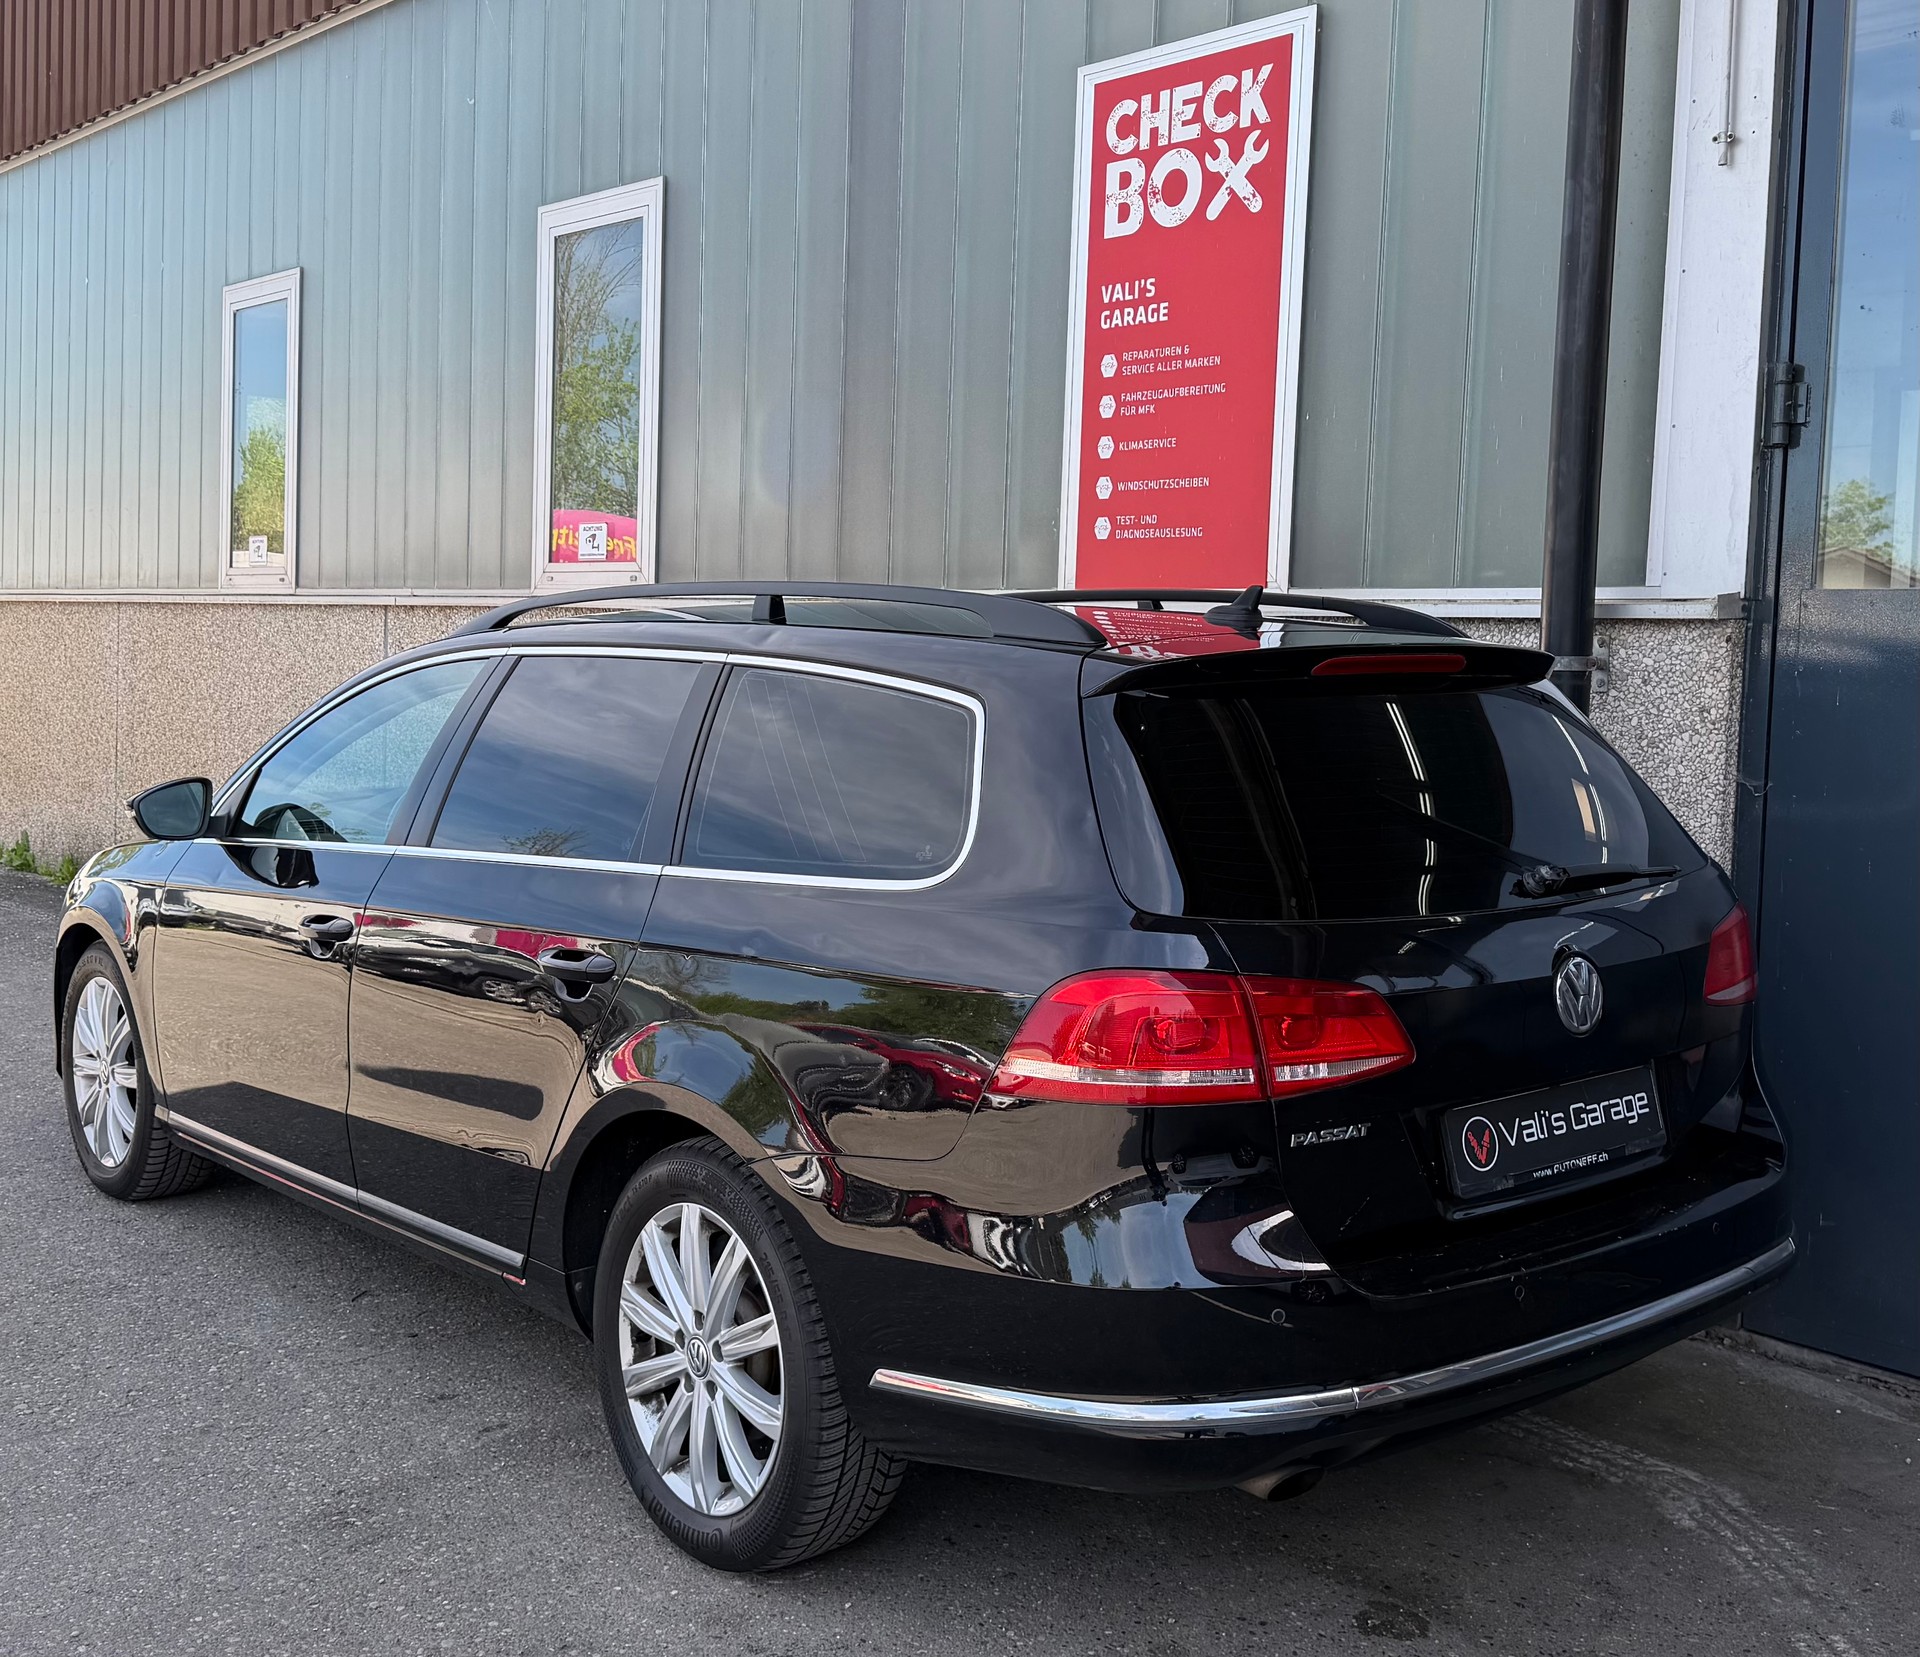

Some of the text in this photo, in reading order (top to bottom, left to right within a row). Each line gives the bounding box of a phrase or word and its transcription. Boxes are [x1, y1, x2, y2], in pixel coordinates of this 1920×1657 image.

[1106, 63, 1274, 155] CHECK
[1104, 130, 1270, 239] BOX
[1101, 278, 1156, 304] VALI'S
[1100, 302, 1169, 330] GARAGE
[1122, 345, 1190, 362] REPARATUREN &
[1121, 355, 1221, 376] SERVICE ALLER MARKEN
[1121, 383, 1226, 402] FAHRZEUGAUFBEREITUNG
[1120, 404, 1156, 417] FÜR MFK
[1119, 437, 1177, 451] KLIMASERVICE
[1117, 477, 1210, 491] WINDSCHUTZSCHEIBEN
[1116, 514, 1158, 525] TEST- UND
[1115, 527, 1203, 539] DIAGNOSEAUSLESUNG
[1498, 1092, 1650, 1147] Vali's Garage
[1290, 1122, 1372, 1148] PASSAT
